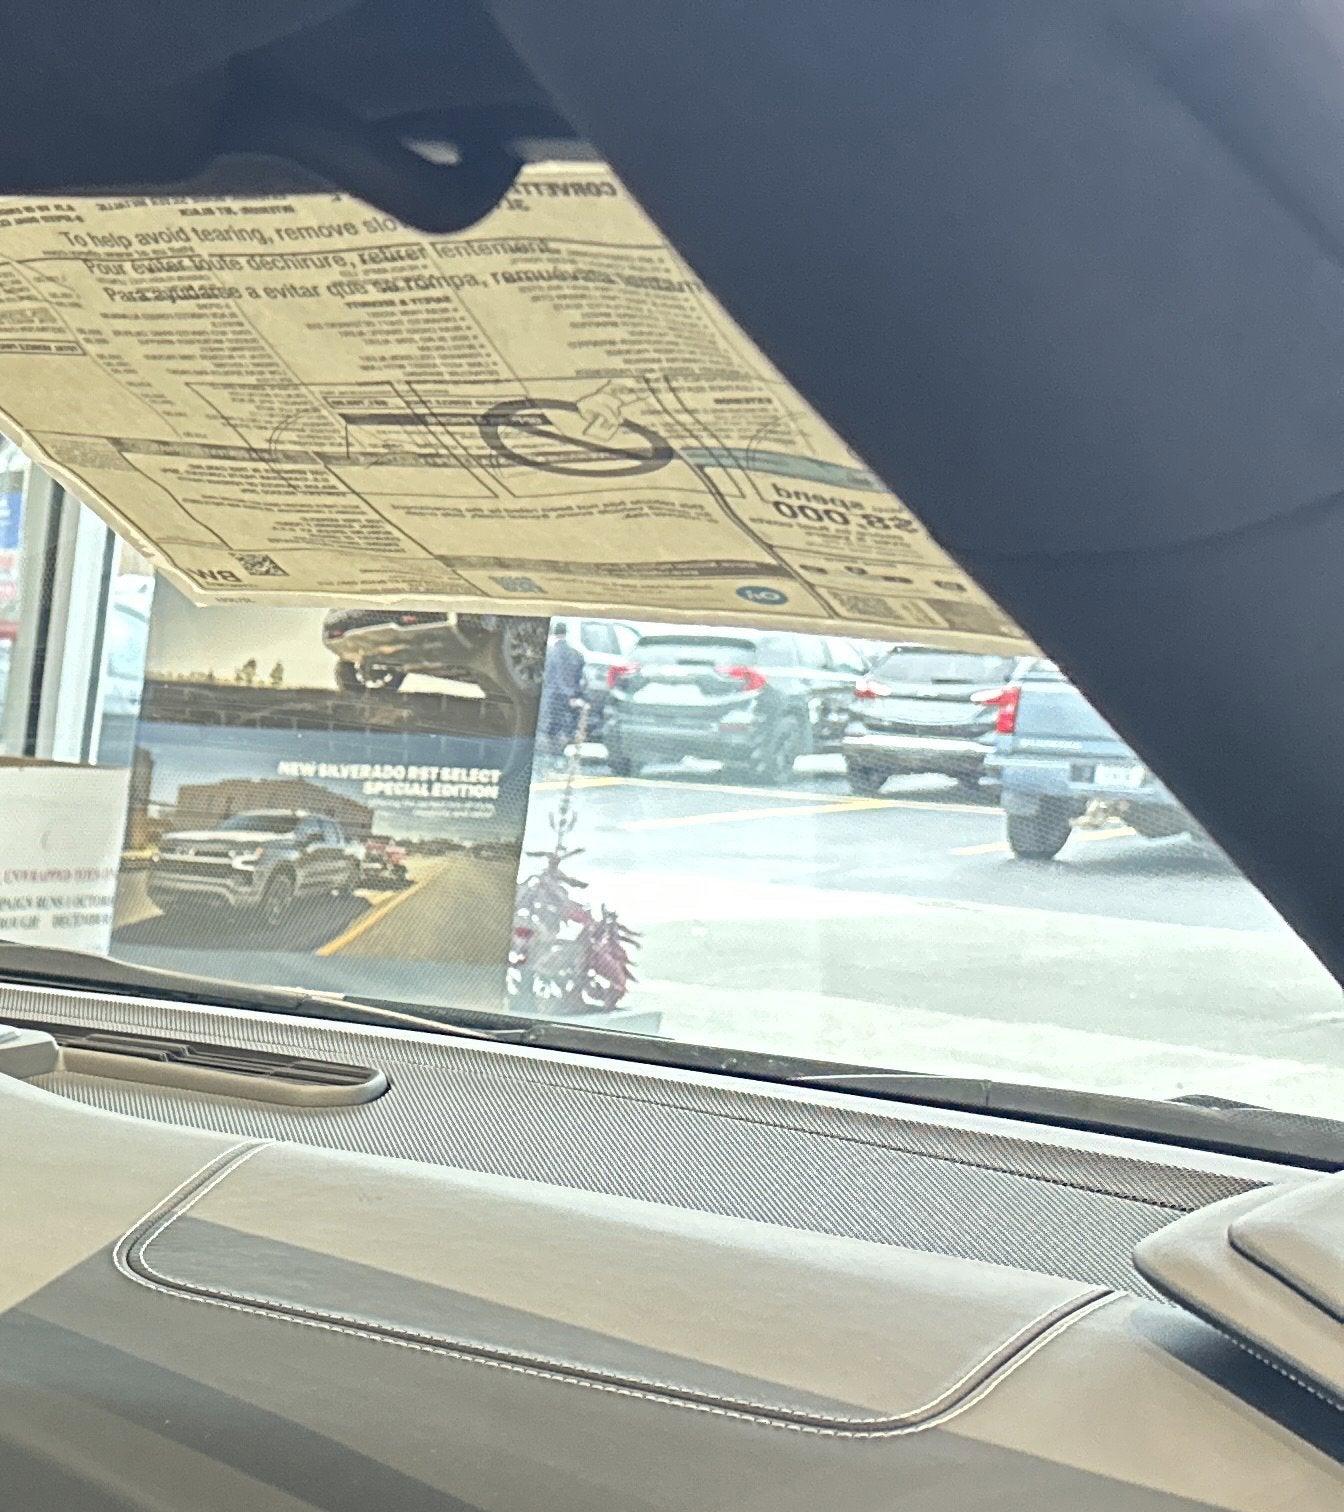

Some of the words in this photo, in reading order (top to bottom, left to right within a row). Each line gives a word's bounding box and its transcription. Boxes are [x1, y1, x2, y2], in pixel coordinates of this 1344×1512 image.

[59, 231, 86, 249] To
[90, 232, 133, 251] help
[135, 226, 191, 246] avoid
[195, 222, 273, 245] tearing,
[276, 222, 359, 241] remove
[362, 216, 401, 234] slo
[83, 258, 128, 276] Pour
[190, 256, 242, 273] toute
[247, 252, 356, 272] déchirure,
[360, 245, 430, 267] retirer
[103, 287, 150, 303] Para
[245, 286, 259, 300] a
[264, 281, 320, 299] evitar
[327, 280, 368, 299] que
[403, 272, 486, 294] rompa,
[278, 761, 314, 777] NEW
[317, 763, 405, 780] SILVERADO
[408, 767, 438, 781] RST
[440, 768, 502, 784] SELECT
[362, 782, 428, 797] SPECIAL
[430, 784, 499, 799] EDITION
